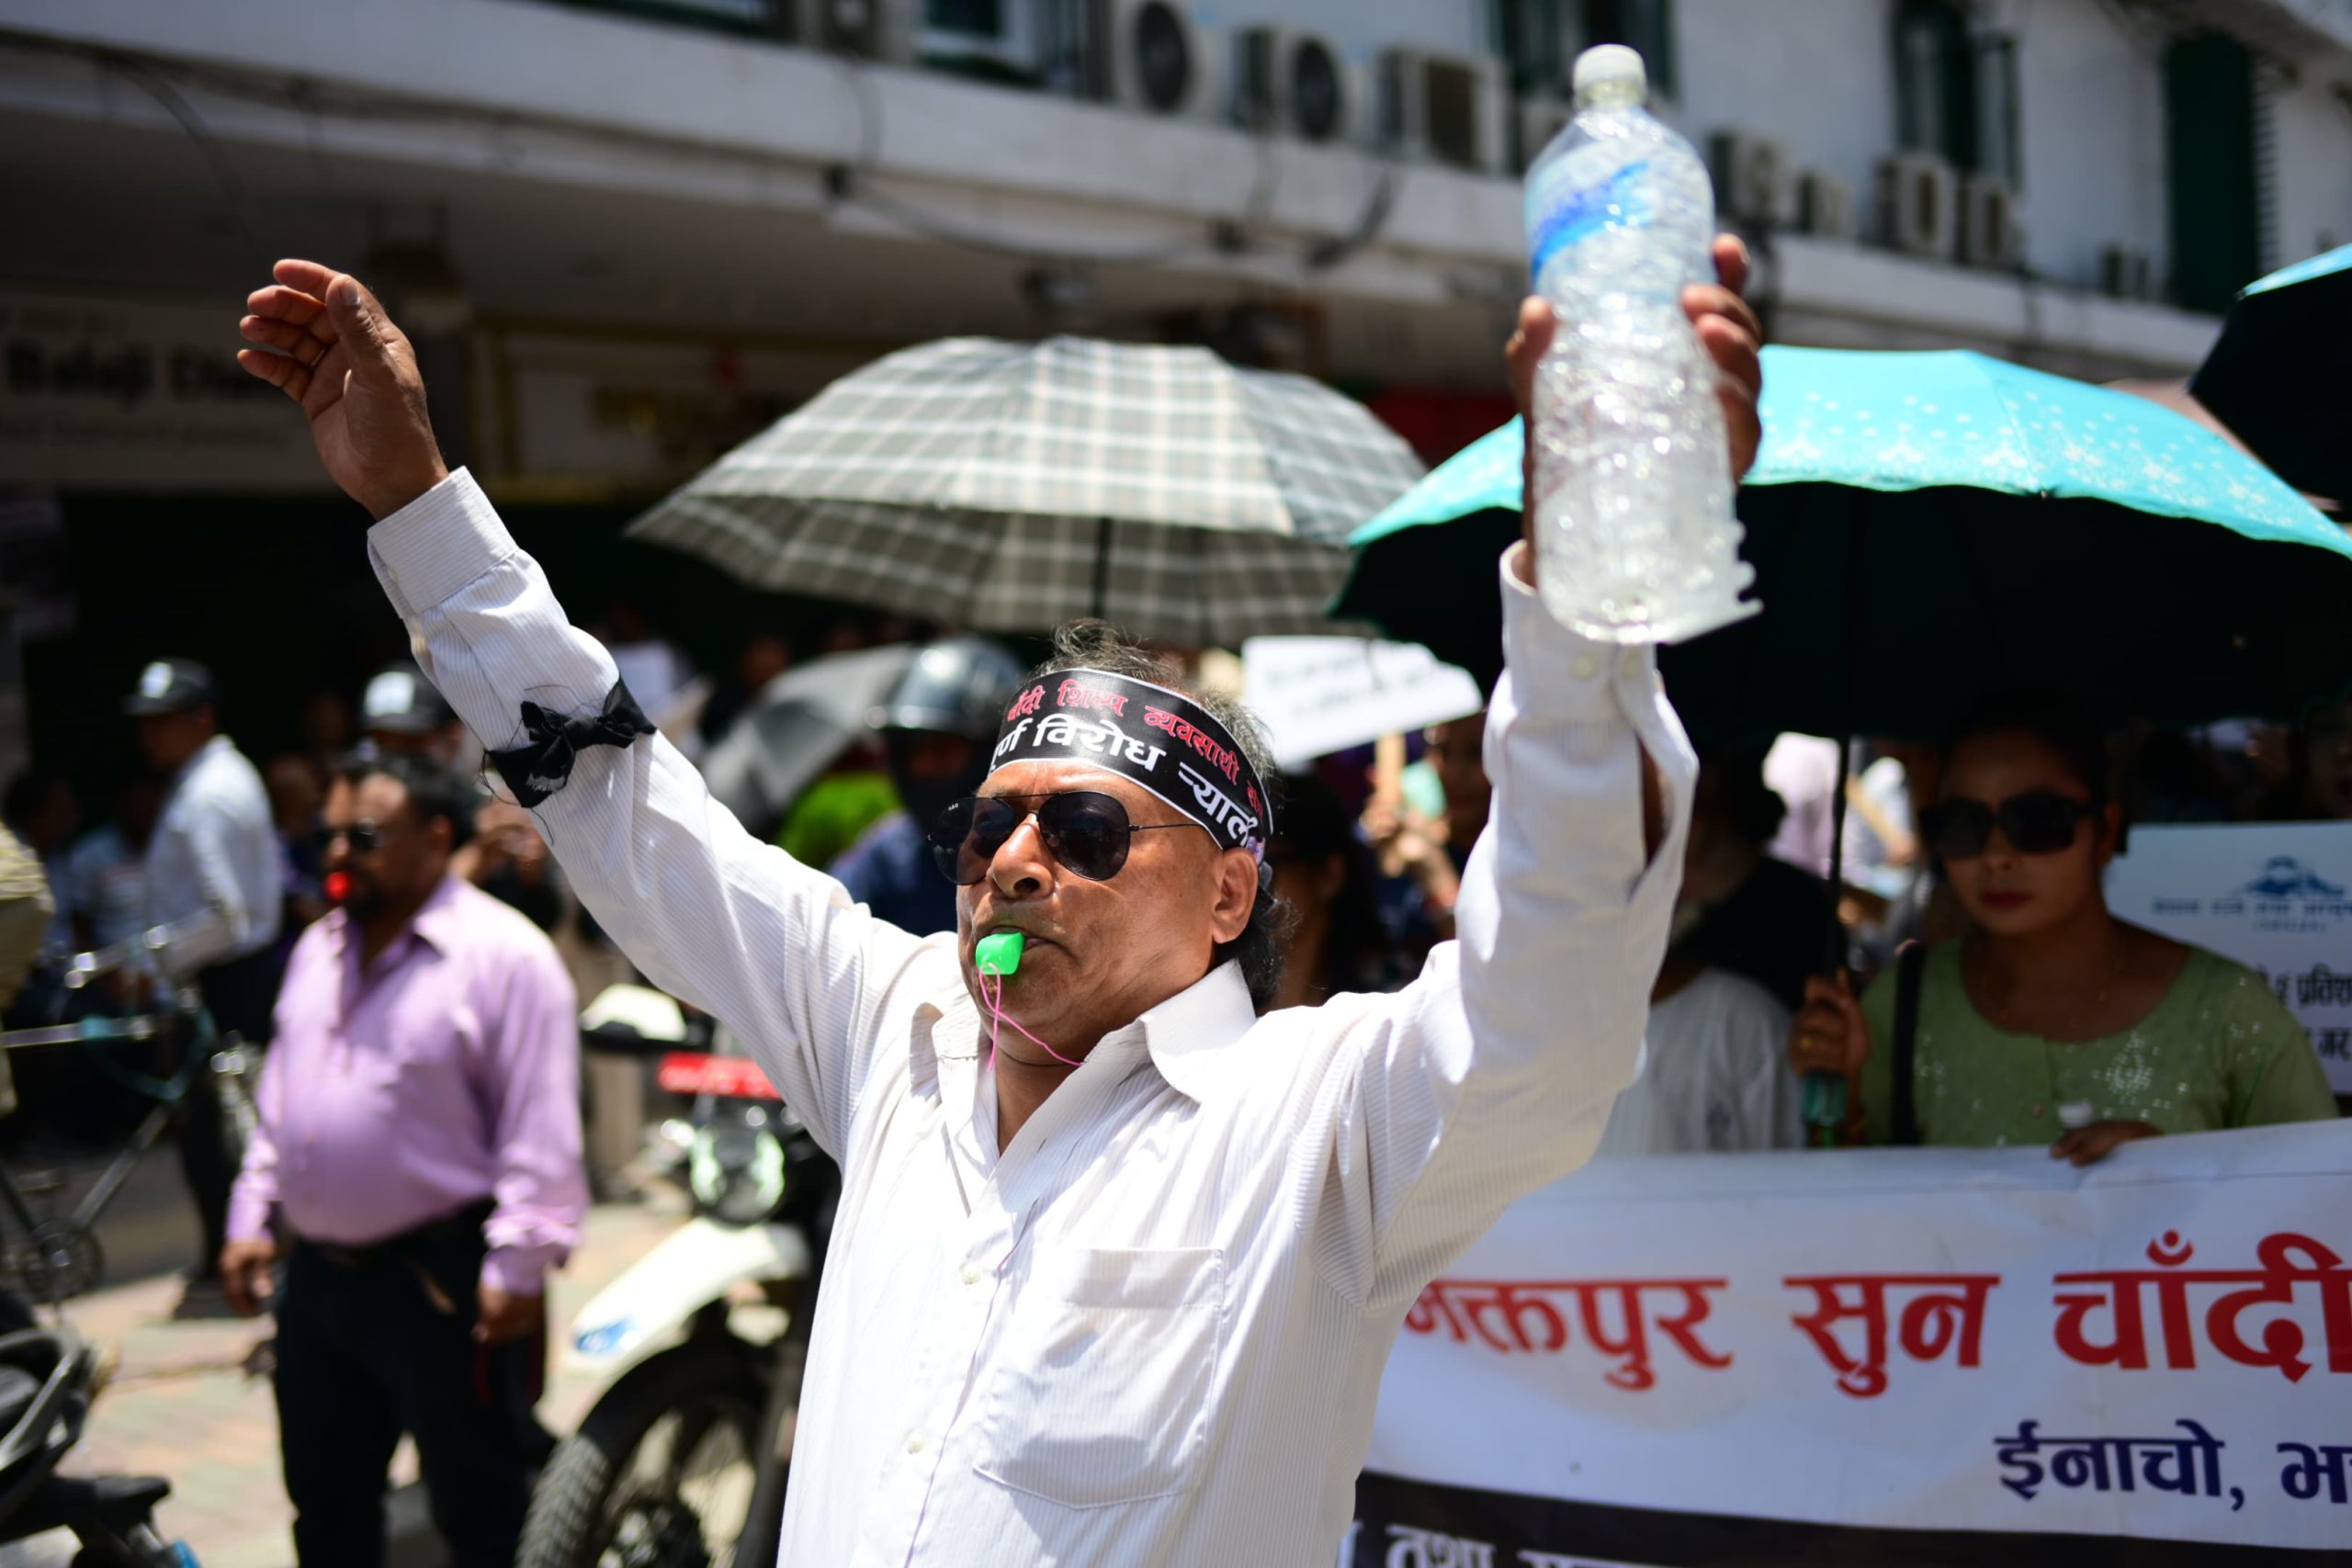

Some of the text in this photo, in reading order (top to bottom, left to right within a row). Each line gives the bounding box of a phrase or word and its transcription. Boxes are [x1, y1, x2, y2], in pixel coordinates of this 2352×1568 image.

[1033, 714, 1167, 773] विरोध
[1056, 679, 1128, 718] शिल्प
[1144, 705, 1239, 786] व्यवसायी
[1782, 1273, 2002, 1399] सुन
[2052, 1230, 2352, 1384] चाँदी
[1995, 1419, 2245, 1511] ईनाचो,
